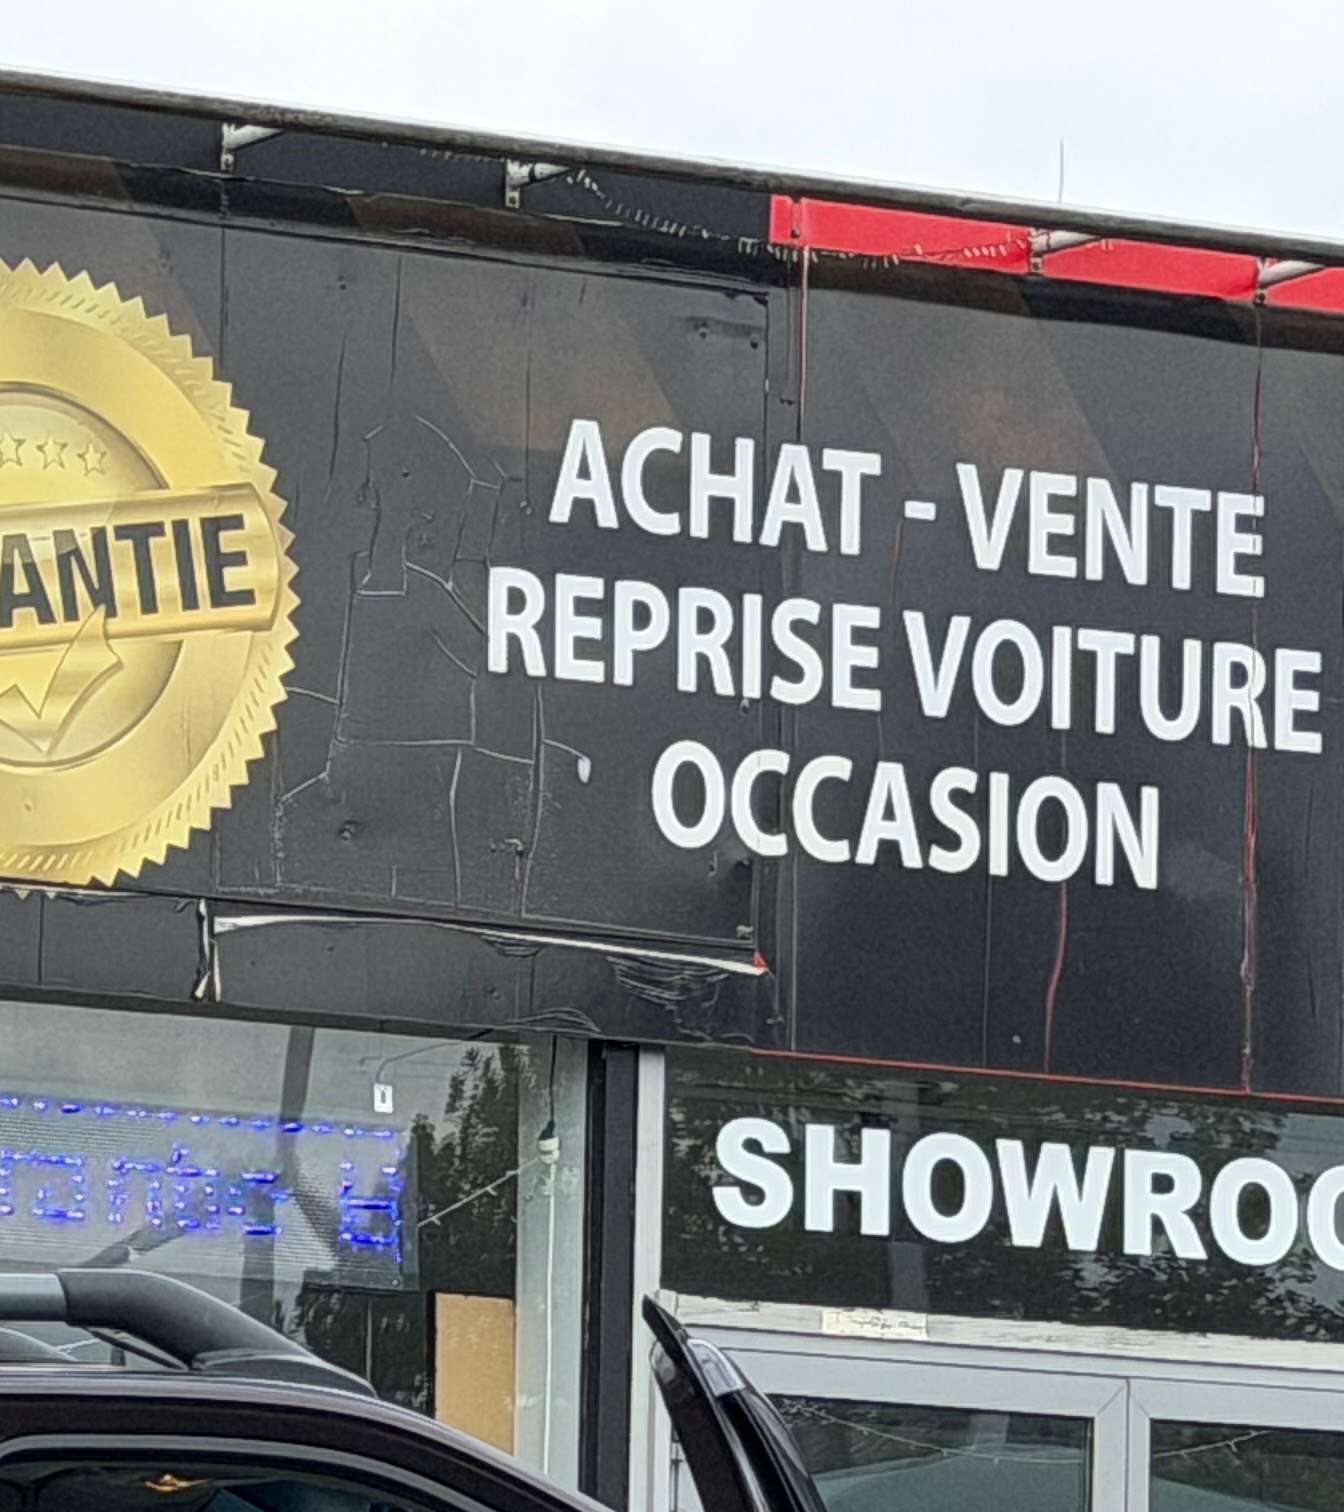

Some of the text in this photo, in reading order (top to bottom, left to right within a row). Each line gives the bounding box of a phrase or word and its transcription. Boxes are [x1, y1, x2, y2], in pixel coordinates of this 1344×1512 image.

[548, 418, 882, 556] ACHAT
[955, 462, 1266, 599] VENTE
[487, 565, 1324, 755] REPRISE VOITURE
[651, 738, 1160, 890] OCCASION
